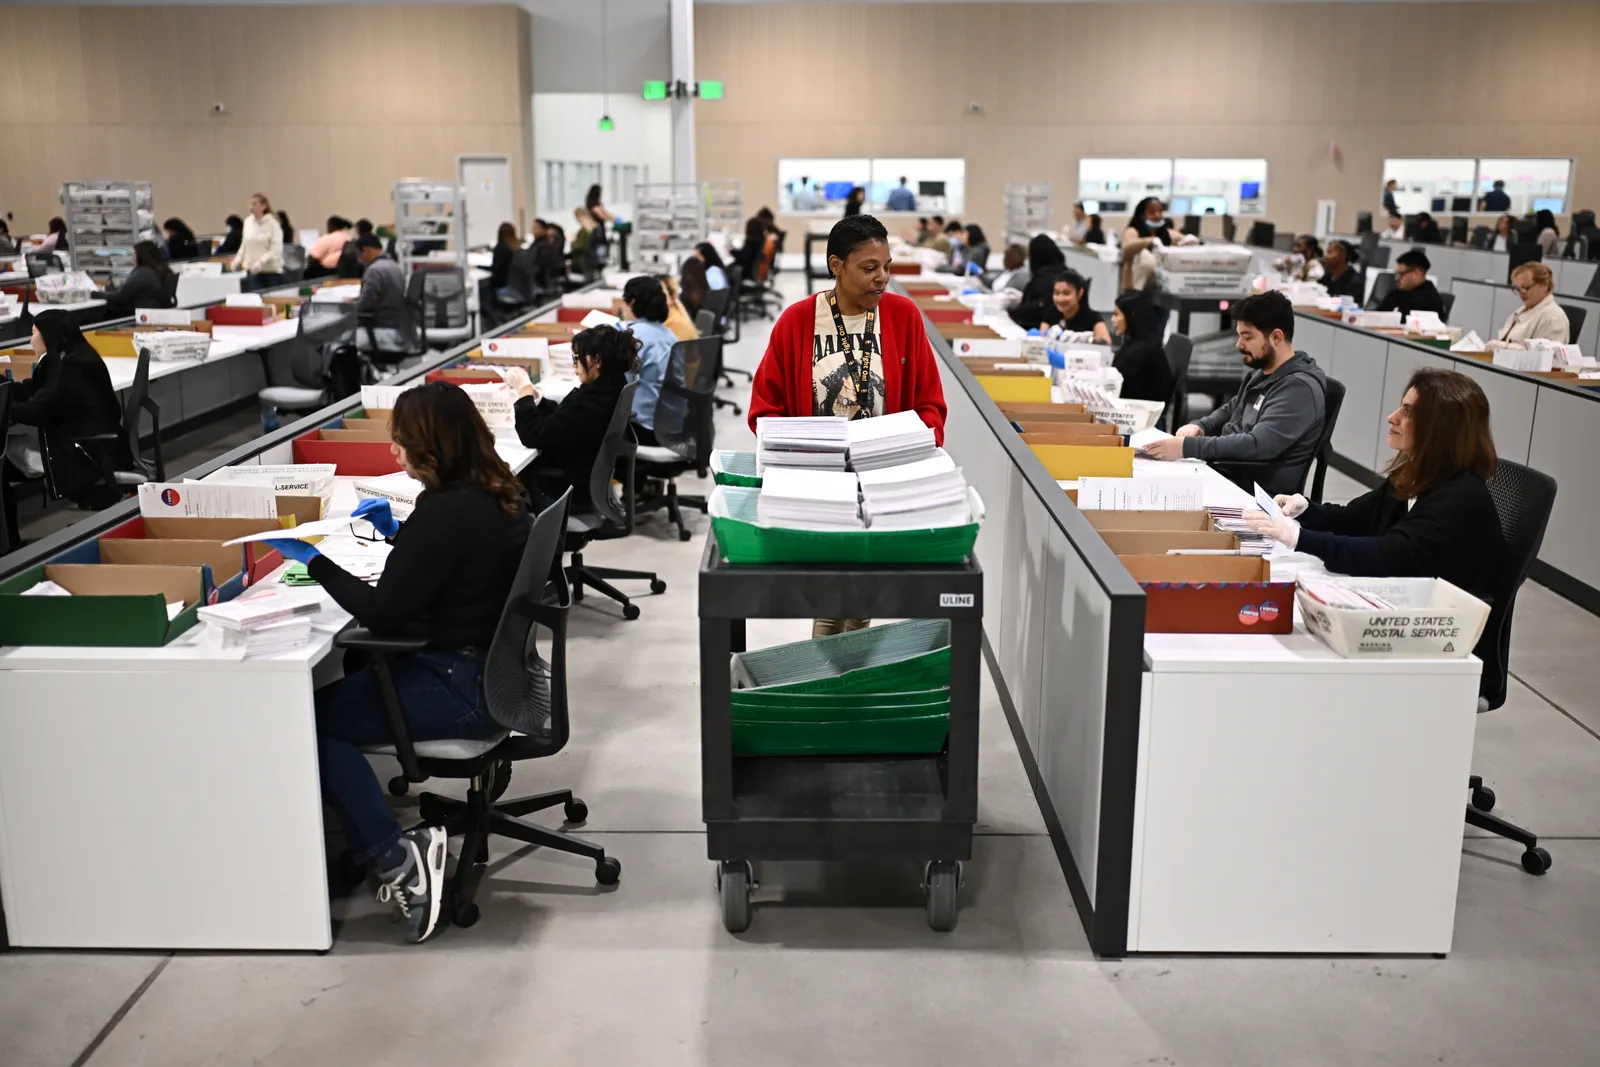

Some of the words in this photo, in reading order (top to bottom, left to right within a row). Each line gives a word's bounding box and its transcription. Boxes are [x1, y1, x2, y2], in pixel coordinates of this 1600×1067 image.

[862, 352, 870, 368] Fight
[395, 496, 414, 505] SERVICE
[942, 596, 972, 605] ULINE
[1369, 617, 1410, 627] UNITED
[1413, 616, 1455, 626] STATES
[1362, 628, 1407, 638] POSTAL
[1410, 628, 1460, 638] SERVICE
